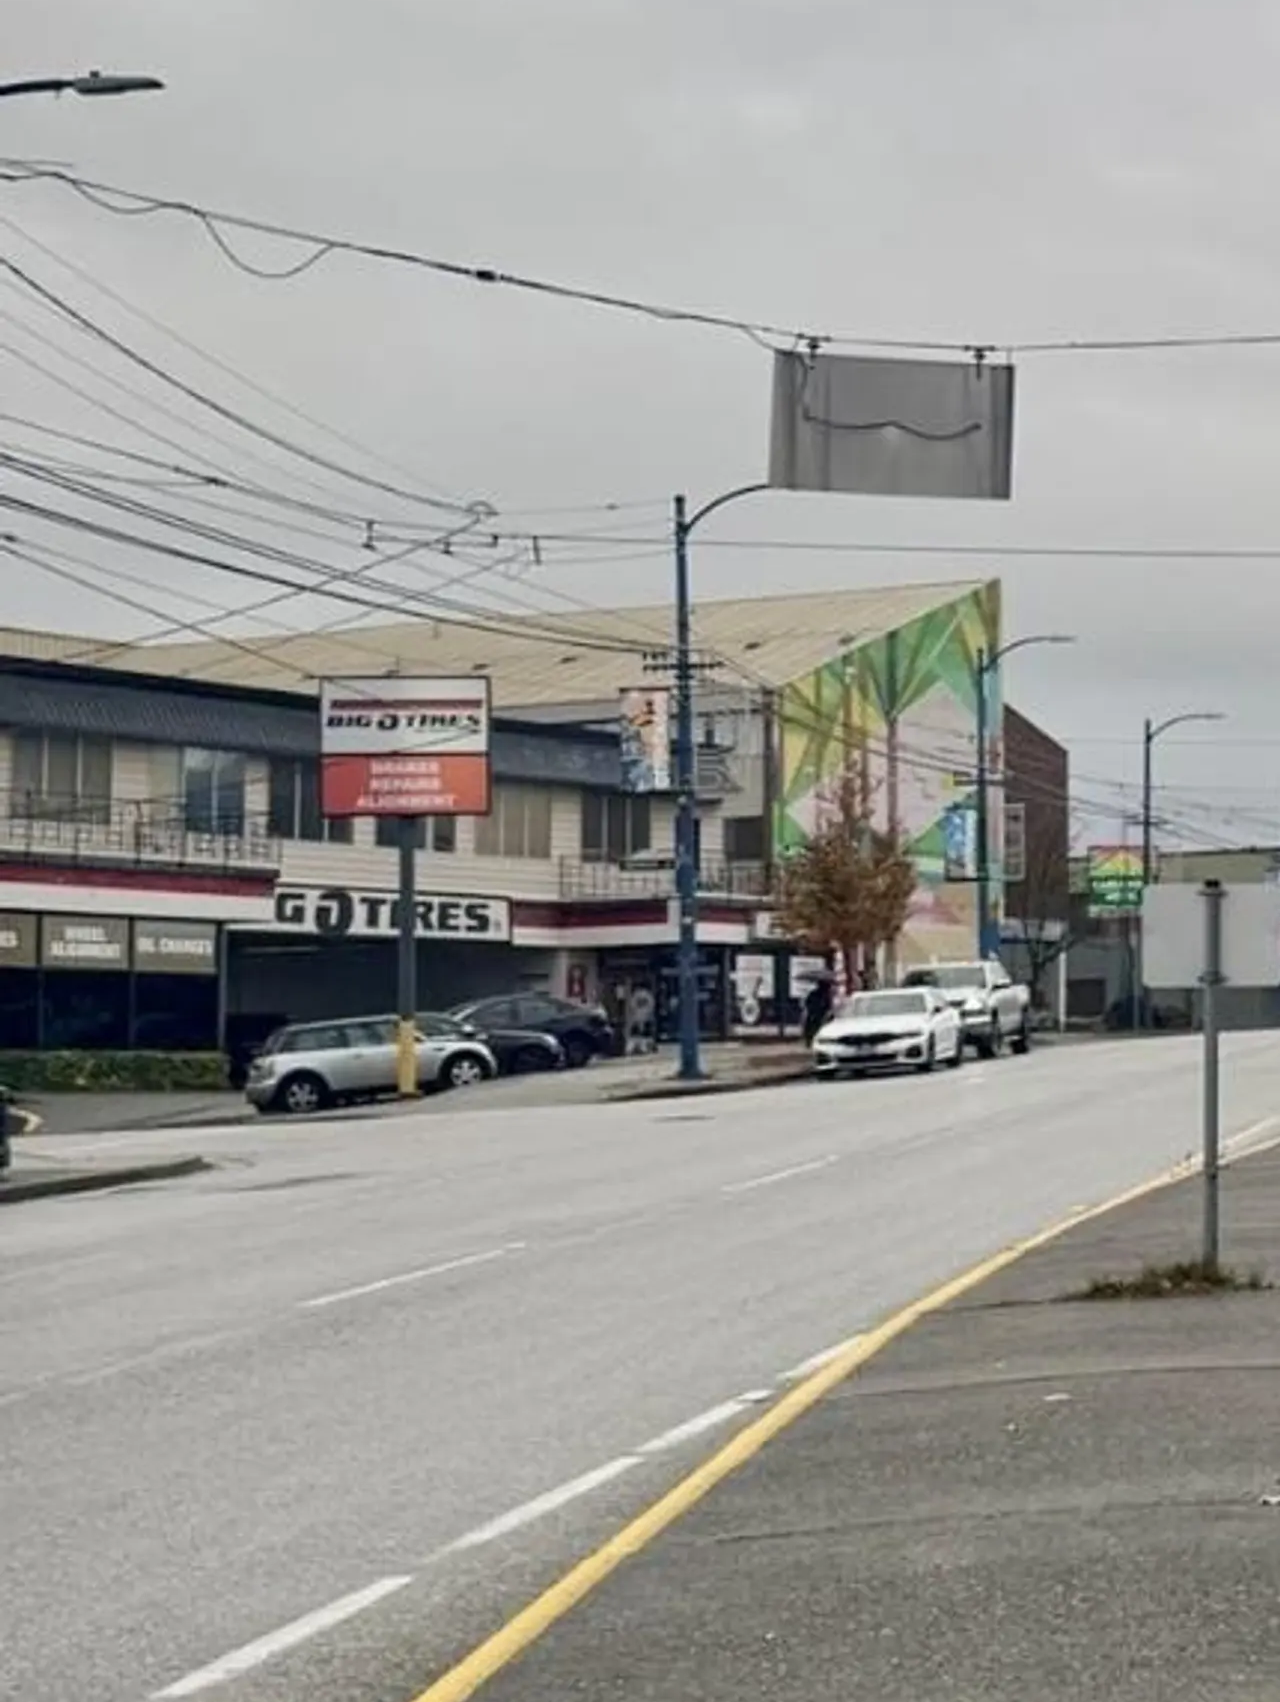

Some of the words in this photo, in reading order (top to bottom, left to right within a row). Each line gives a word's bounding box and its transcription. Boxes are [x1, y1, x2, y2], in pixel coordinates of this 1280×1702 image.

[327, 714, 372, 728] BIG
[357, 794, 454, 809] ALIGNMENT
[360, 897, 490, 932] TIRES
